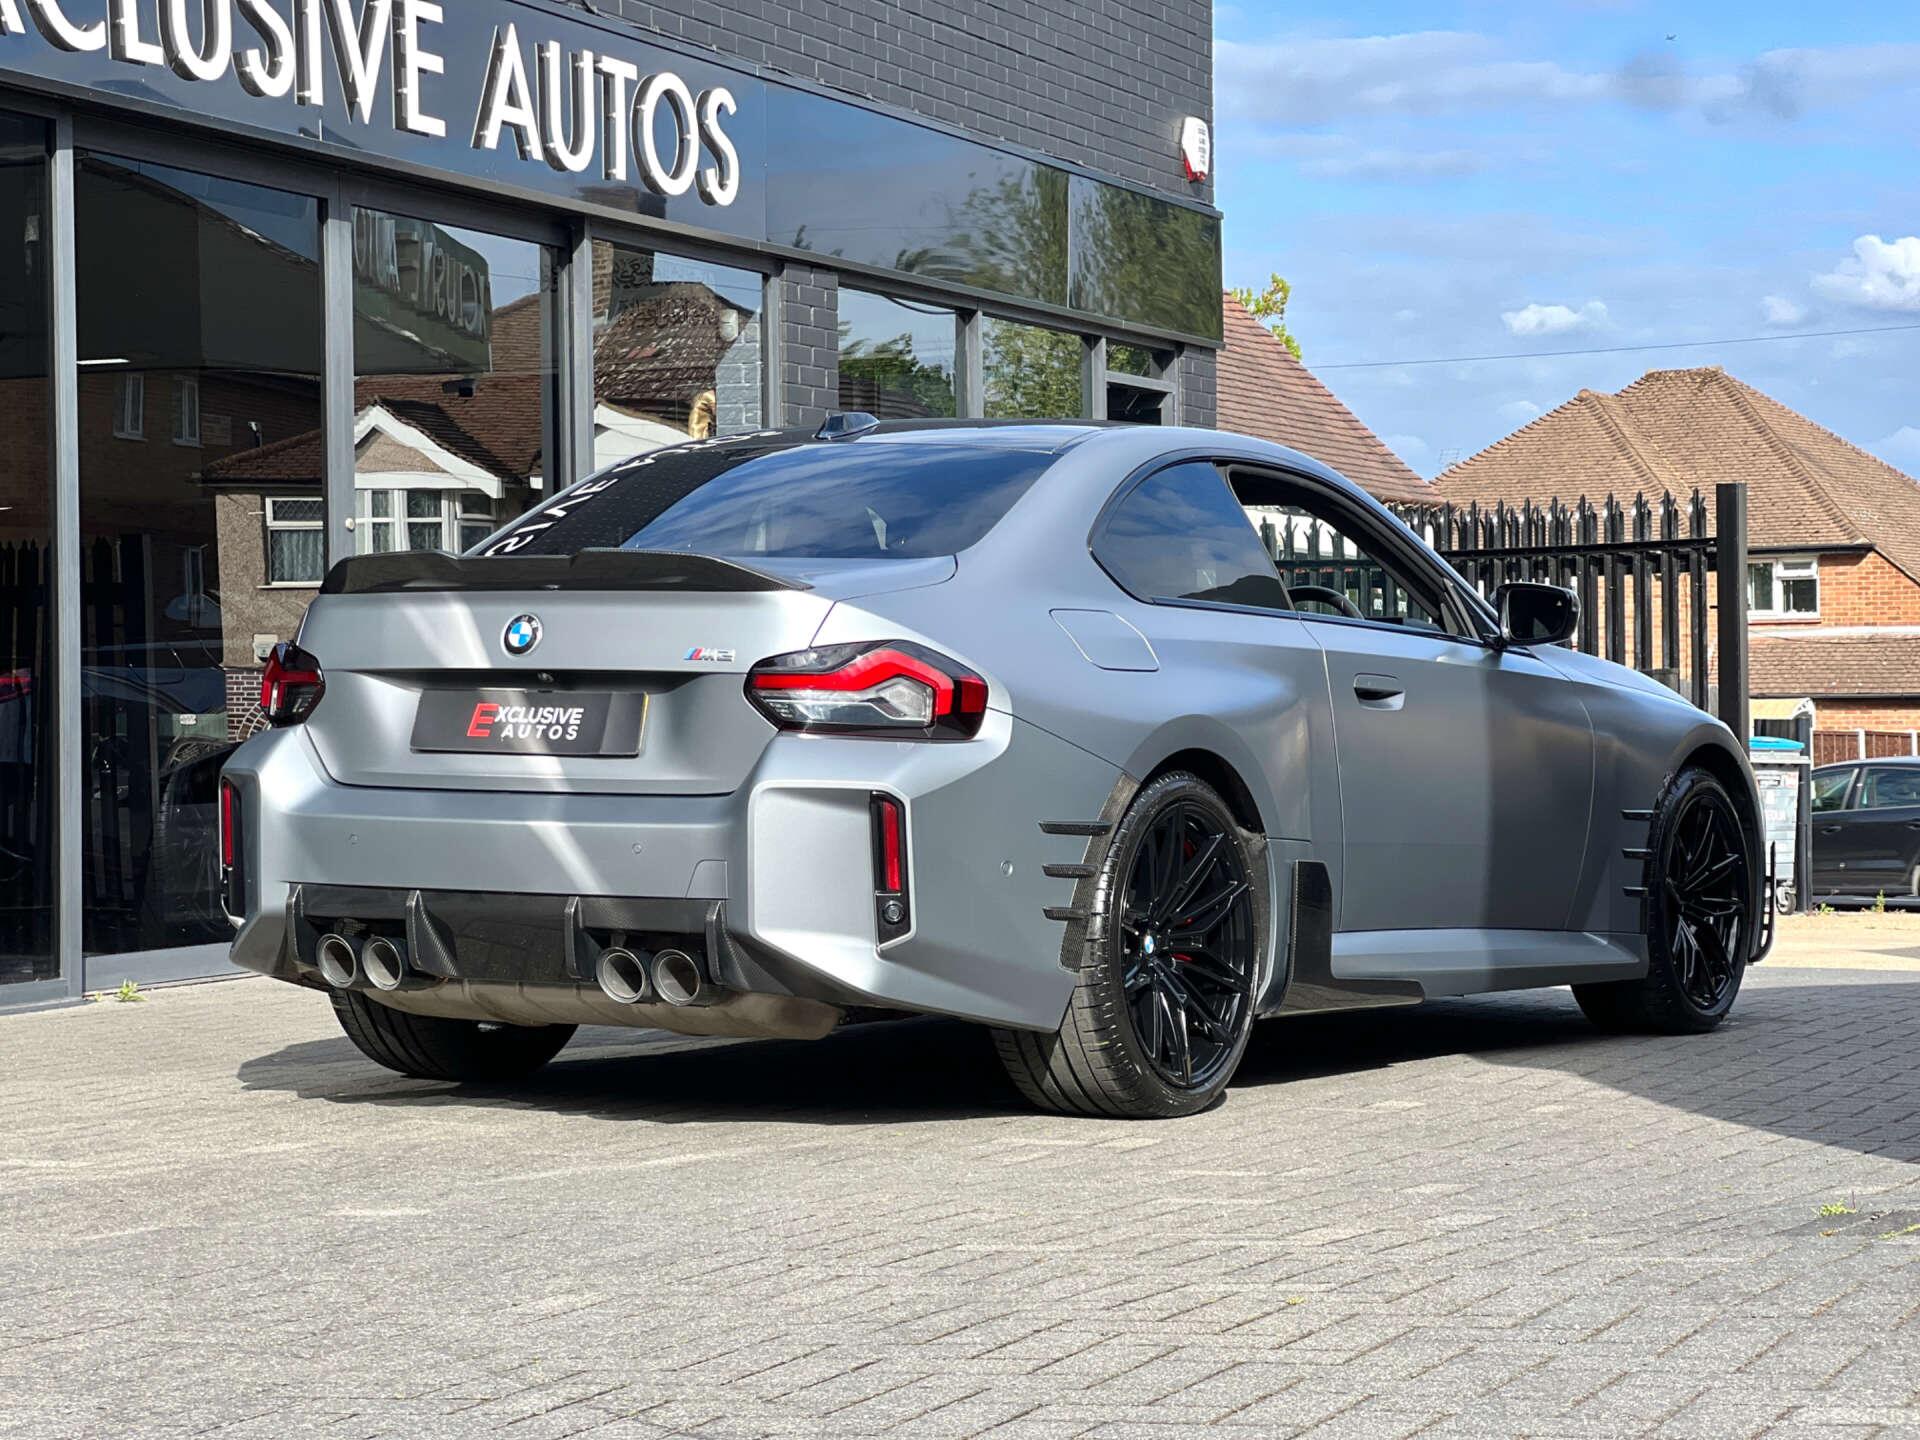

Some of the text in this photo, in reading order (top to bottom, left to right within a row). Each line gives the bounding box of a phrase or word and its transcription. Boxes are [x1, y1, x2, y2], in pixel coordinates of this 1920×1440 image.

[0, 0, 739, 206] USIVE AUTOS
[467, 703, 584, 737] EXCLUSIVE
[501, 724, 579, 741] AUTOS
